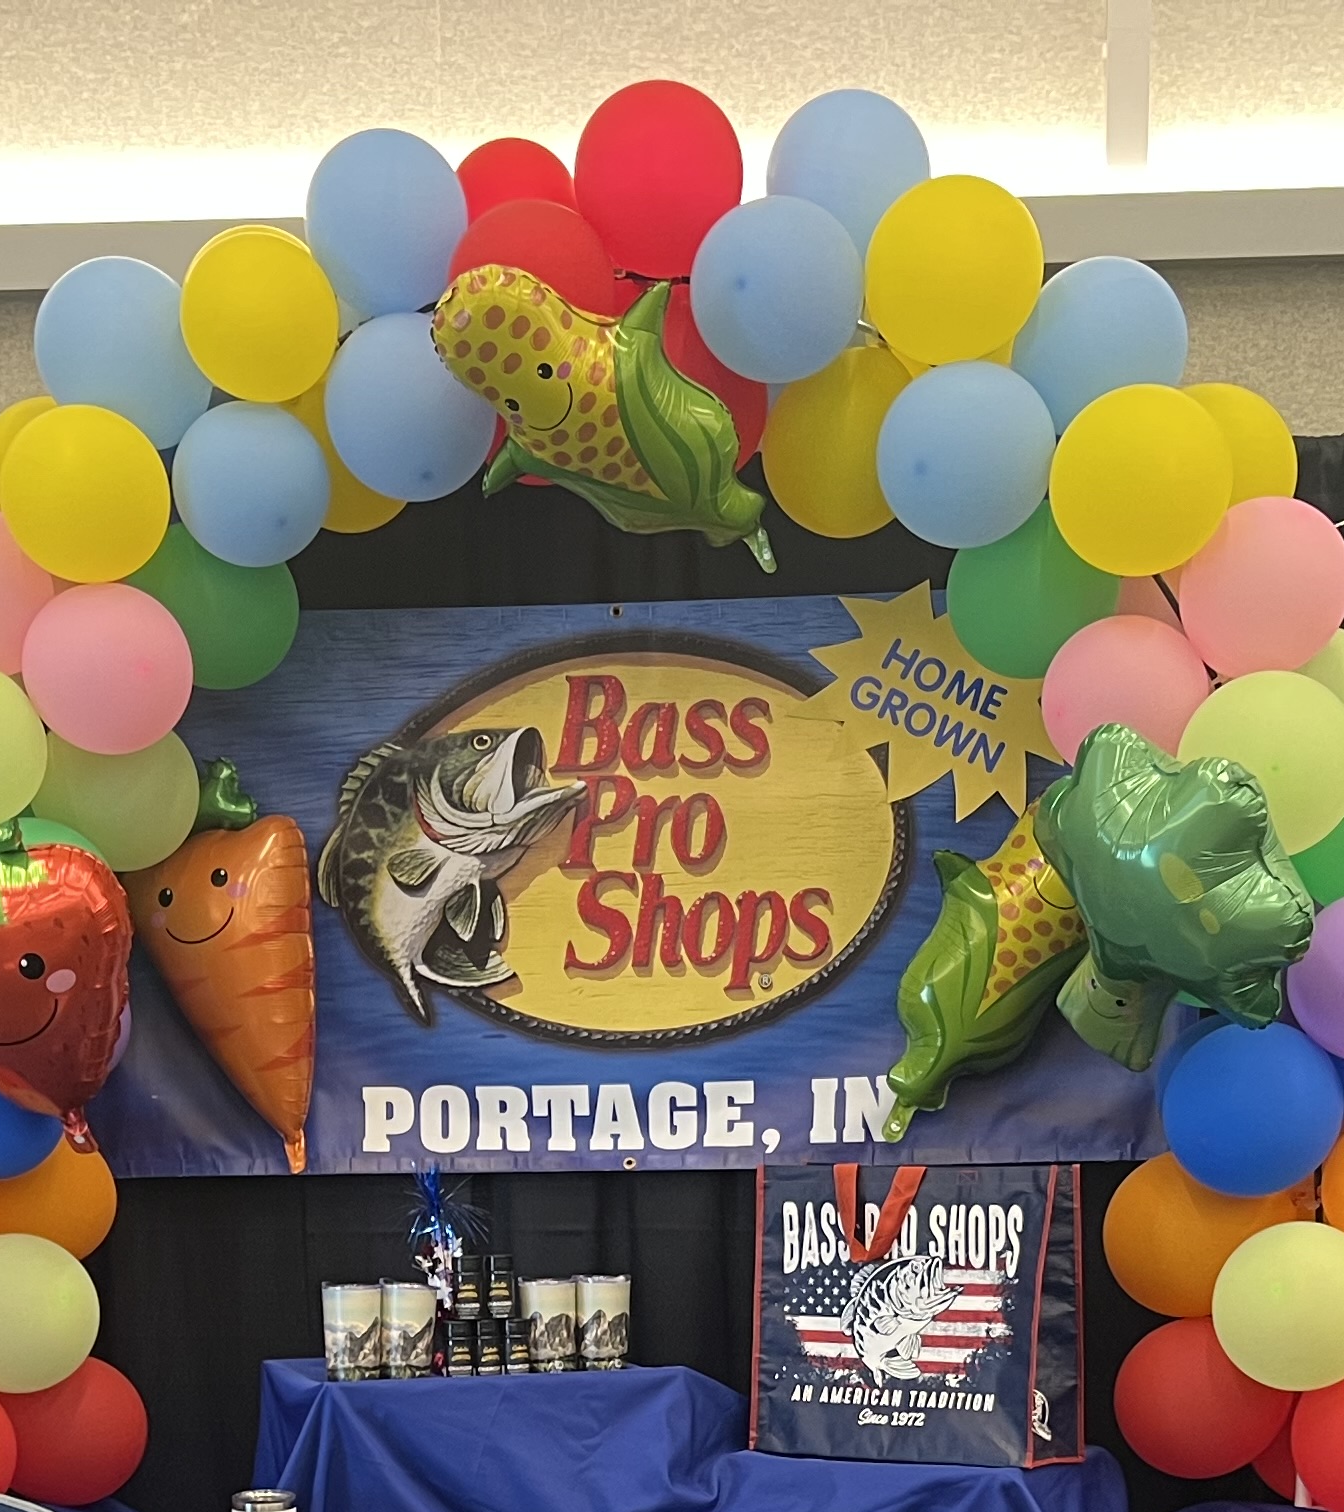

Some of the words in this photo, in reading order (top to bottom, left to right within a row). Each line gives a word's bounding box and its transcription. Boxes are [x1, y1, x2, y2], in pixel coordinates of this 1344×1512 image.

[881, 637, 1009, 721] HOME
[549, 674, 772, 776] Bass
[848, 674, 1009, 774] GROWN
[559, 774, 725, 874] Pro
[563, 871, 834, 1000] Shops
[360, 1079, 783, 1156] PORTAGE,
[809, 1074, 898, 1144] IN
[928, 1203, 1024, 1279] SHOPS
[790, 1384, 814, 1404] AN
[819, 1386, 903, 1408] AMERICAN
[909, 1390, 995, 1413] TRADITION
[857, 1408, 888, 1426] Since
[890, 1411, 925, 1427] 1972
